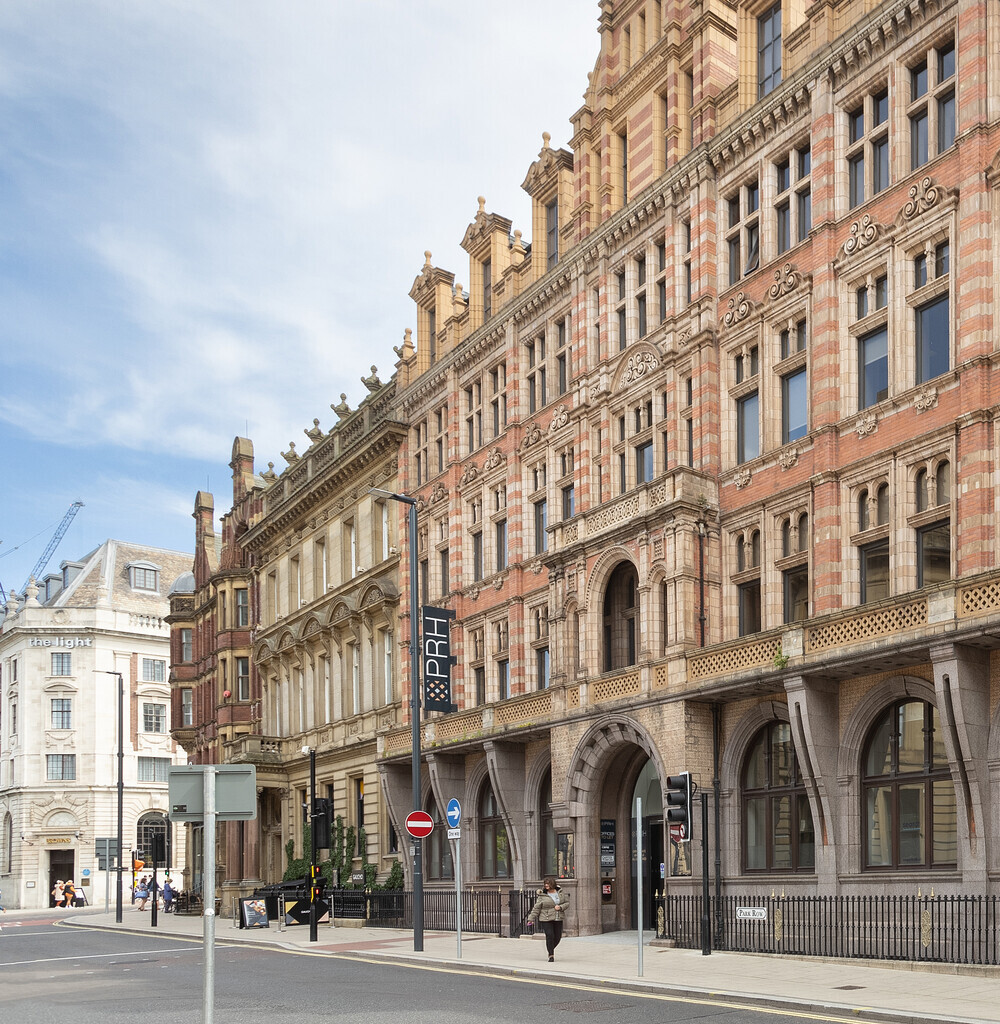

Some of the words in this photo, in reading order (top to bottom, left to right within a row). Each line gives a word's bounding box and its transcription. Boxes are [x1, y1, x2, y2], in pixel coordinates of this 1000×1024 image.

[29, 637, 51, 647] the
[55, 637, 92, 649] light
[425, 616, 448, 678] PRH
